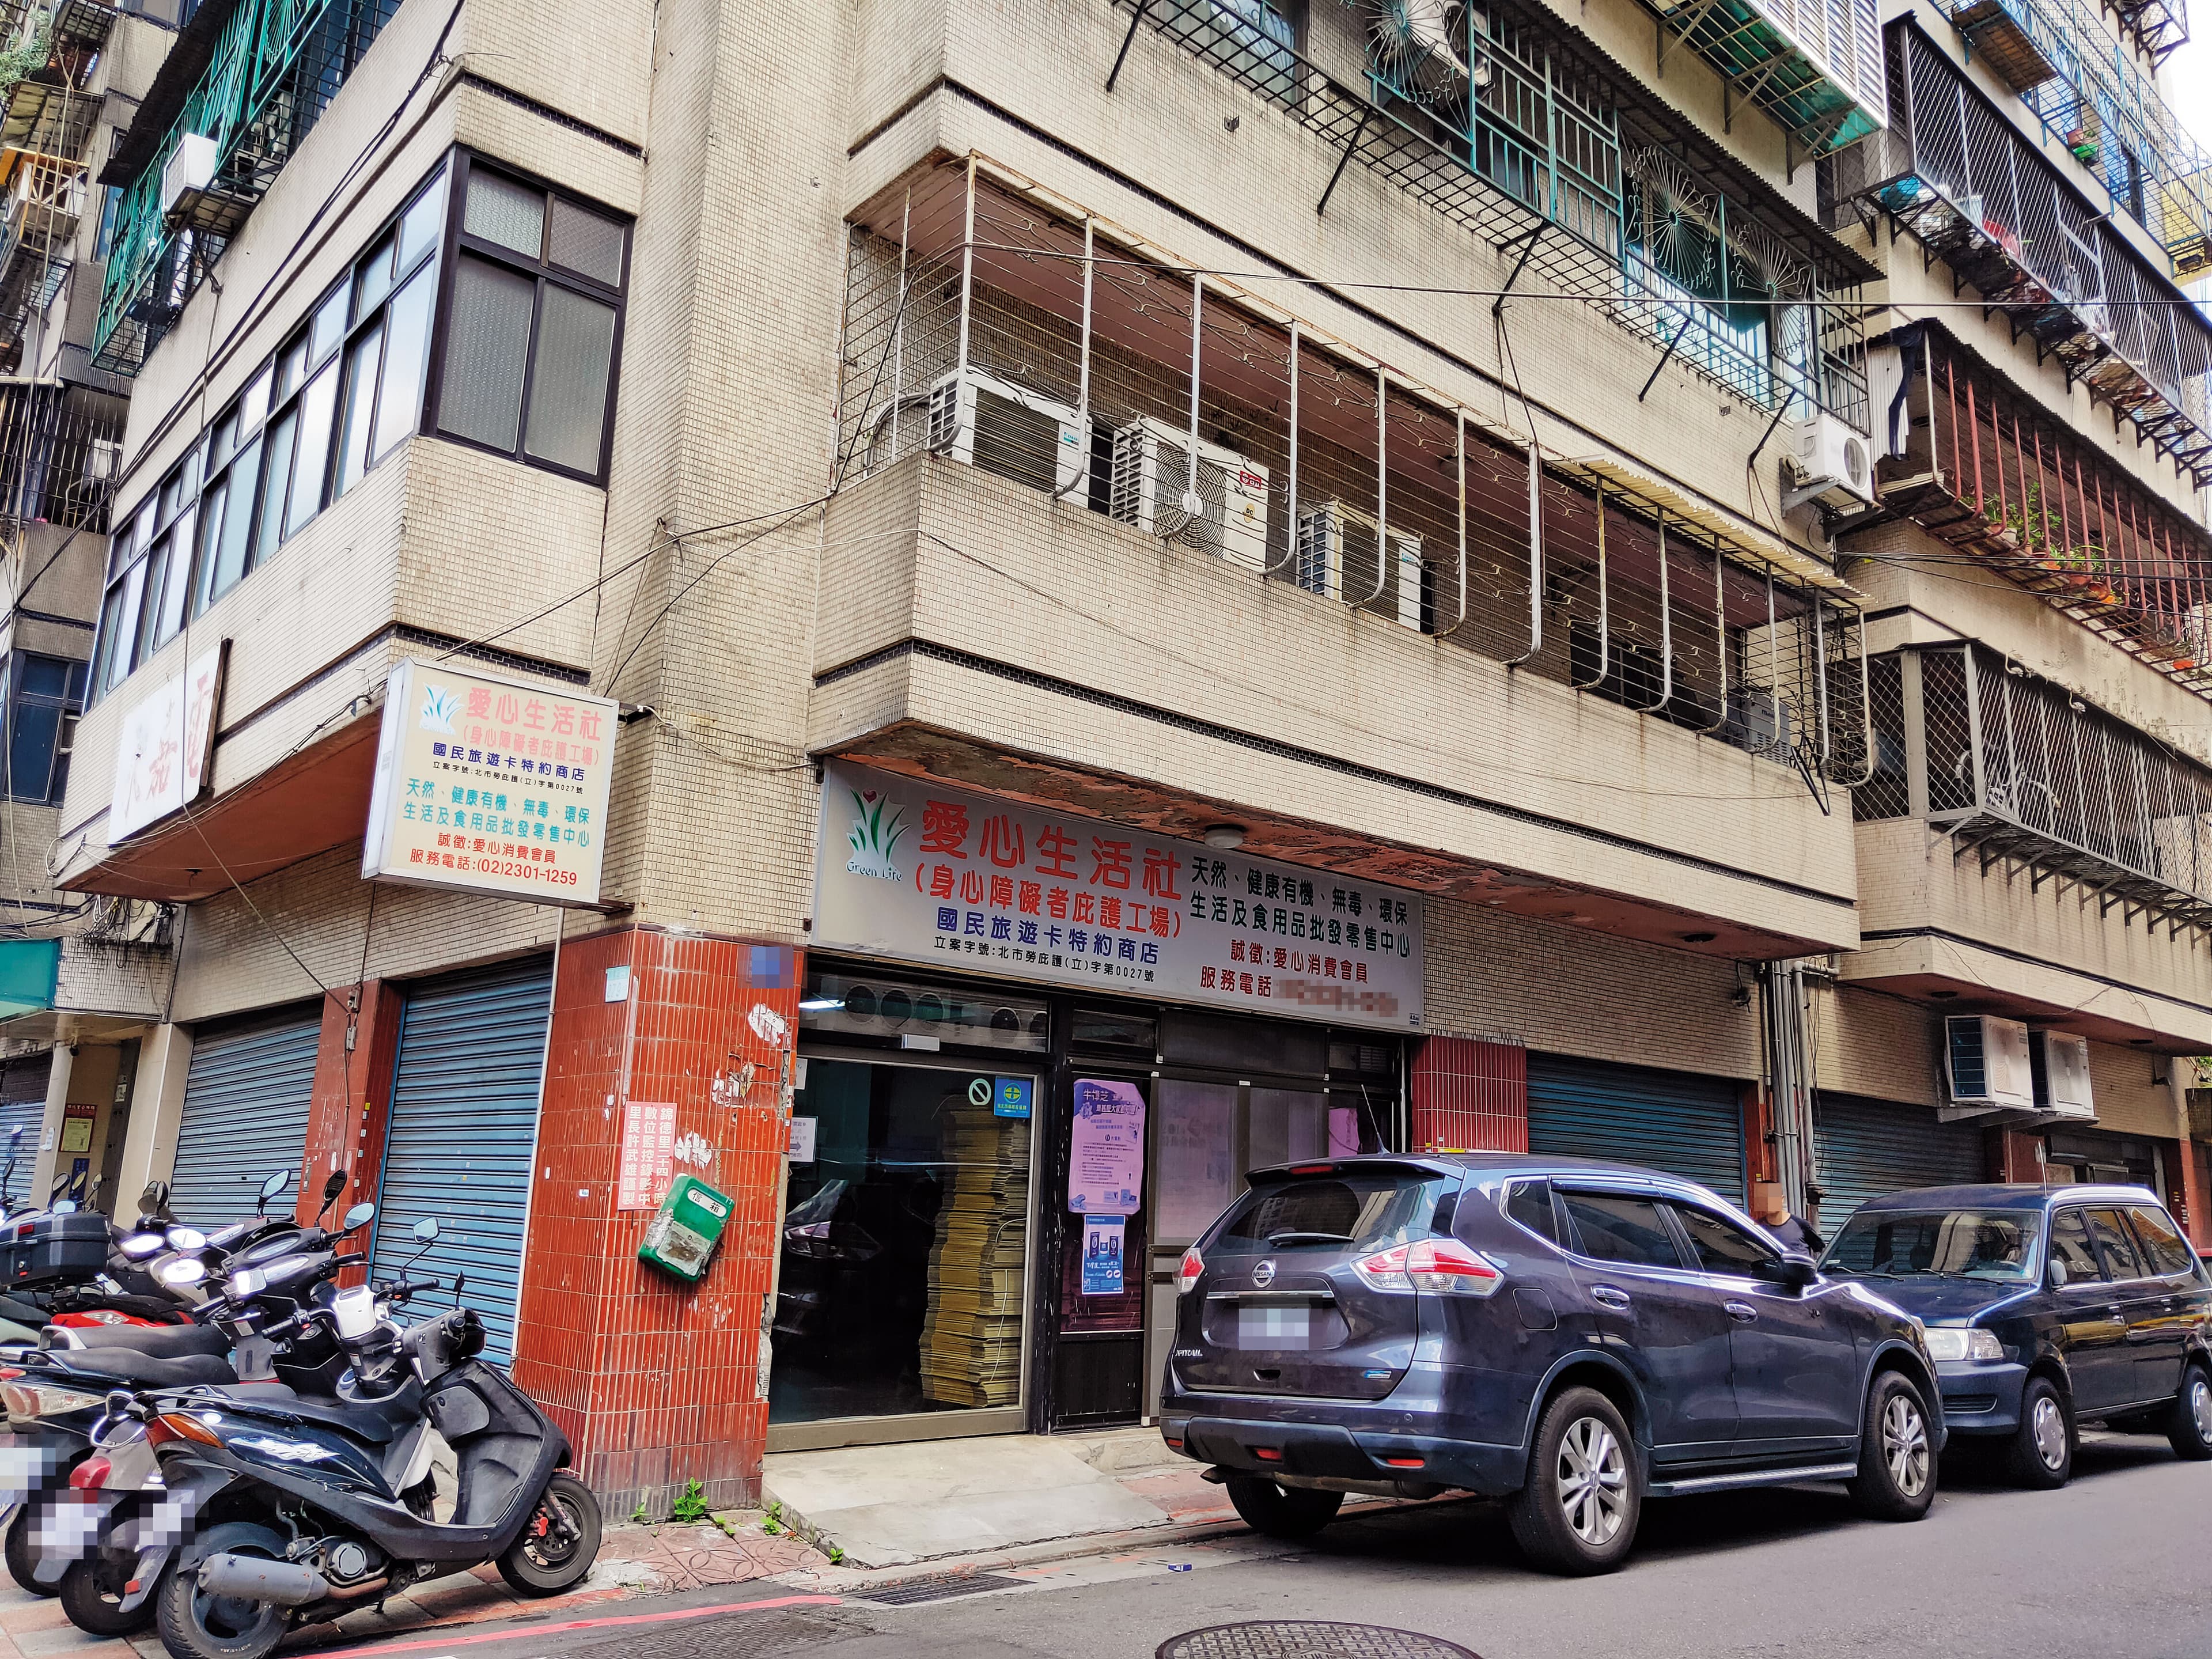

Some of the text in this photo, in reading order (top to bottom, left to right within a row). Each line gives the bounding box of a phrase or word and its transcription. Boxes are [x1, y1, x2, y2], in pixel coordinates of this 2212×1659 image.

[1246, 507, 1253, 516] DC
[466, 687, 603, 742] 愛心生活社
[433, 741, 585, 781] 國民旅遊卡特約商店
[463, 724, 600, 766] (身心障礙者庇護工場)
[403, 801, 590, 848] 生活及食用品批發零售中心
[406, 777, 590, 825] 天然、健康有機、無毒、環保
[410, 848, 577, 885] 服務電話:(02)2301-1259
[437, 832, 556, 865] 誠徵:愛心消費會員
[847, 861, 902, 881] Green Life
[919, 799, 1182, 901] 愛心生活社
[915, 862, 1180, 939] (身心障礙者庇護工場)
[1191, 855, 1408, 927] 天然、健康有機、無毒、環保
[937, 906, 1160, 965] 國民旅遊卡特約商店
[1190, 890, 1411, 958] 生活及食用品批發零售中心
[934, 935, 1155, 983] 立案字號:北市勞庇護(立)字第0027號
[1230, 939, 1369, 984] 誠徵:愛心消費會員
[638, 1107, 657, 1205] 數位監控錄影中
[654, 1107, 673, 1205] 錦德里二十四小時
[692, 1191, 721, 1213] 信箱
